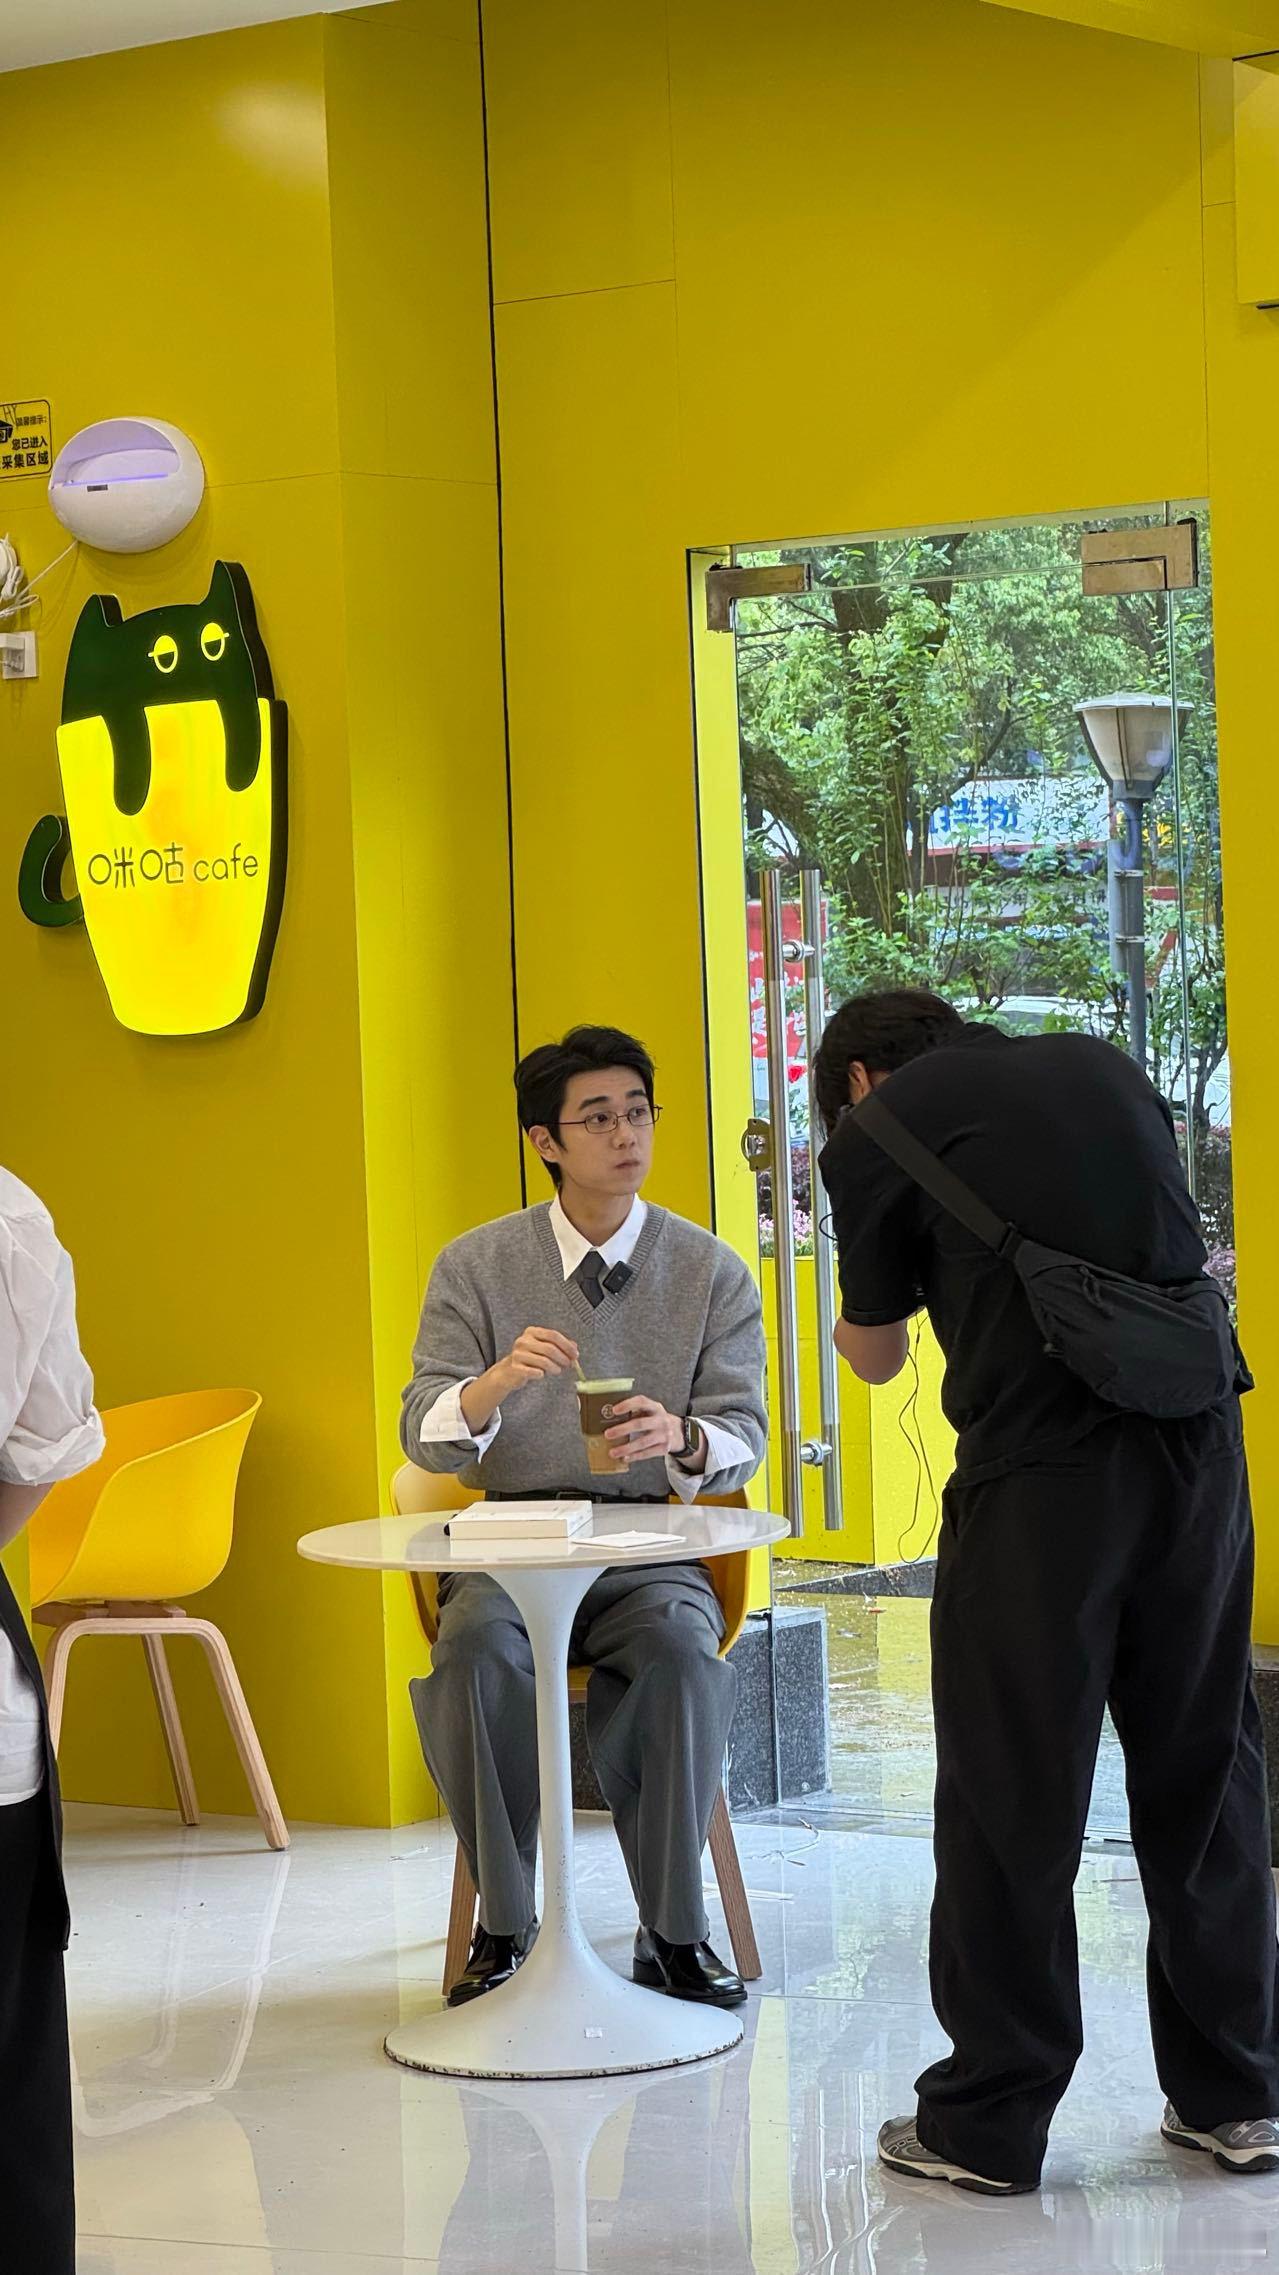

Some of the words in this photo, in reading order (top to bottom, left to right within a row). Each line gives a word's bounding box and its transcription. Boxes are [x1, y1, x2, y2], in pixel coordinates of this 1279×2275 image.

[12, 436, 48, 450] 您已进入
[87, 841, 184, 889] 咪咕
[193, 842, 259, 883] cafe
